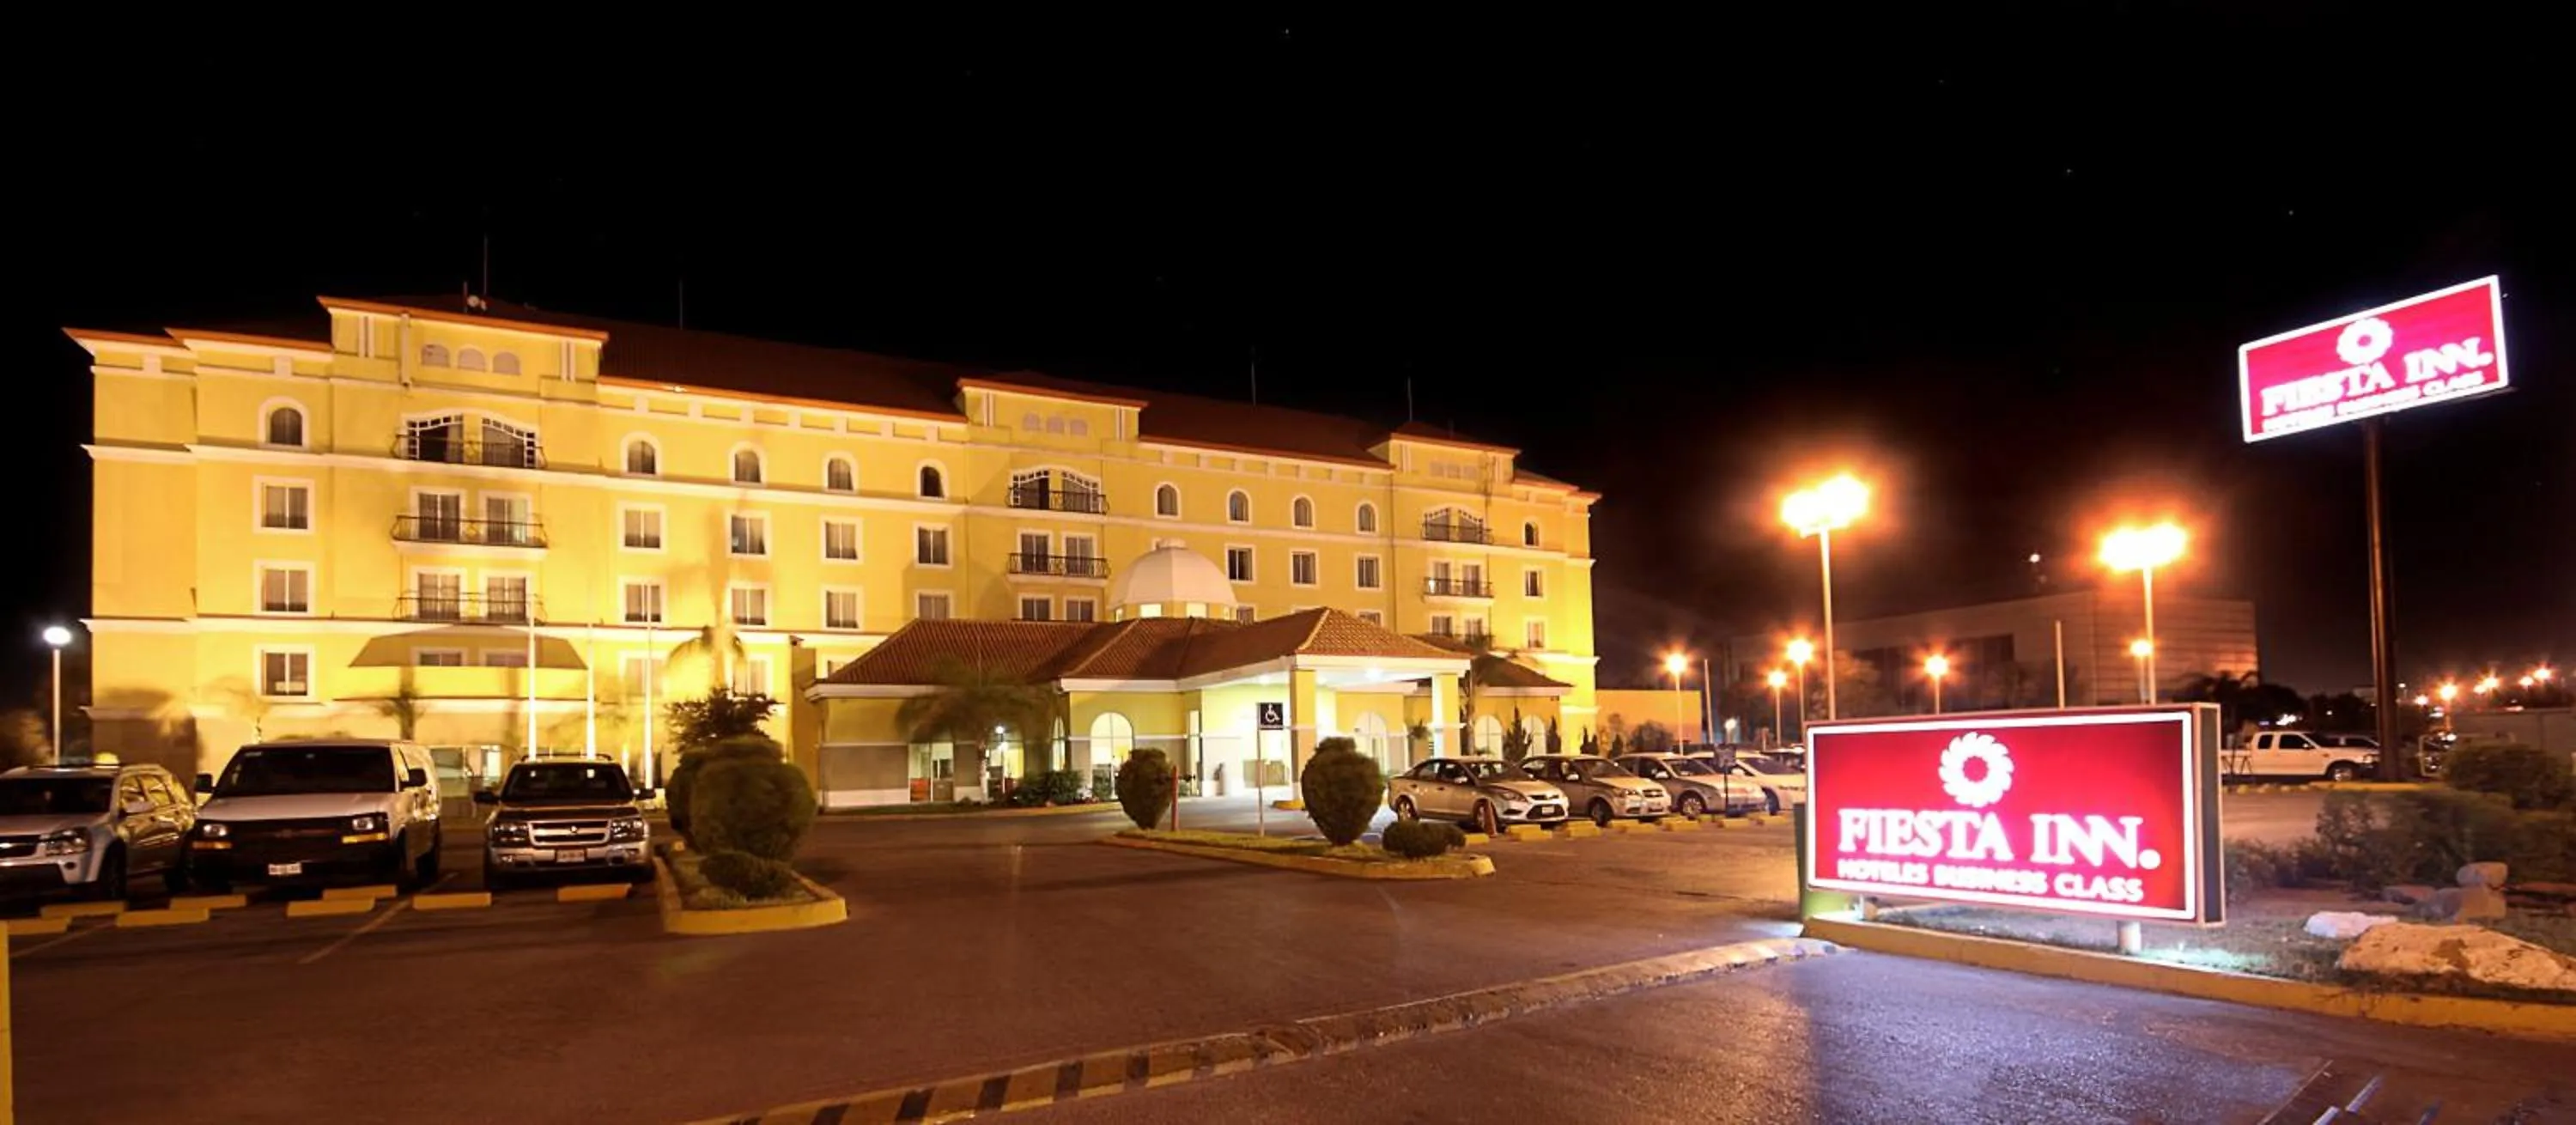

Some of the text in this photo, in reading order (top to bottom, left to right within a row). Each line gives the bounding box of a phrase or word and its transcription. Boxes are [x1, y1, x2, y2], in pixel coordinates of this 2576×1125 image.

[2261, 362, 2396, 416] FIESTA
[1838, 808, 2014, 860] FIESTA
[1838, 859, 1929, 885] HOTELES
[2054, 873, 2144, 902] CLASS
